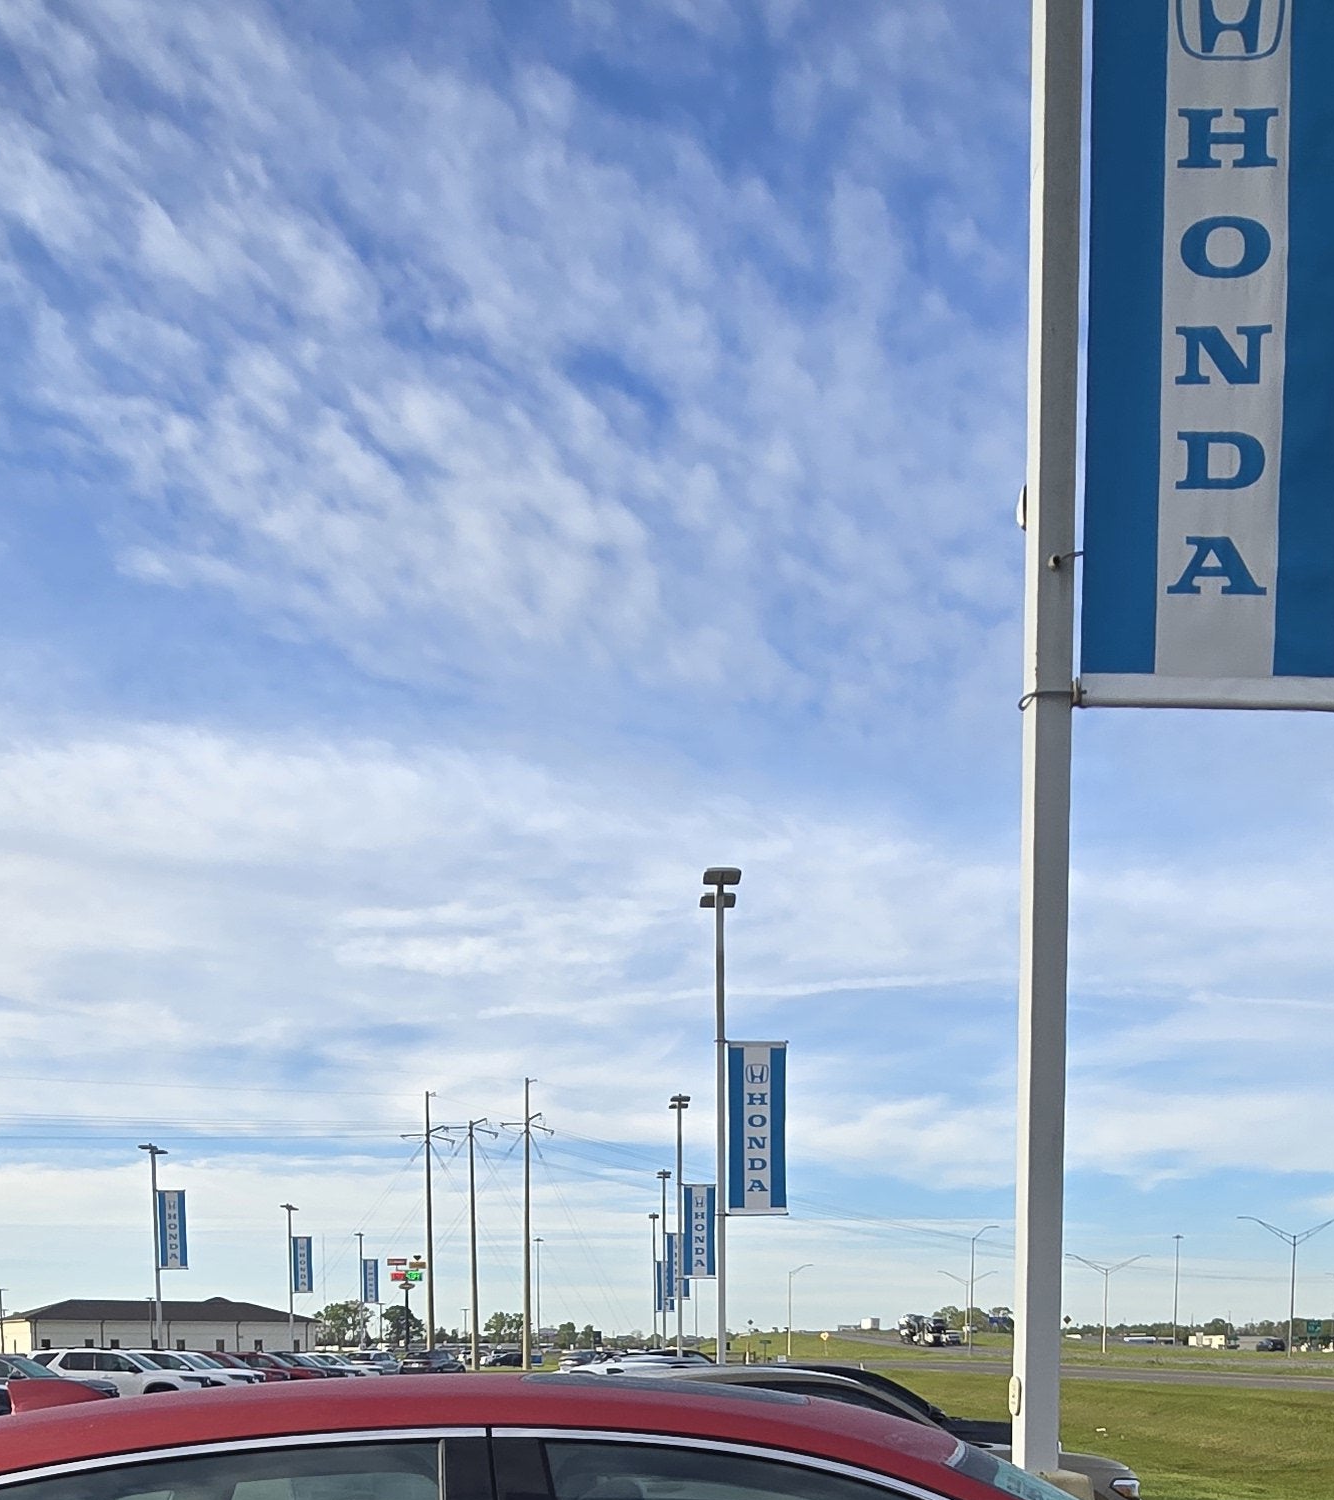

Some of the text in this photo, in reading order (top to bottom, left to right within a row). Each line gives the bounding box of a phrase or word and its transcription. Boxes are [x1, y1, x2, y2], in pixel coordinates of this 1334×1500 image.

[1166, 107, 1279, 596] HONDA
[747, 1092, 768, 1192] HONDA
[167, 1213, 179, 1260] HONDA
[694, 1211, 705, 1268] HONDA
